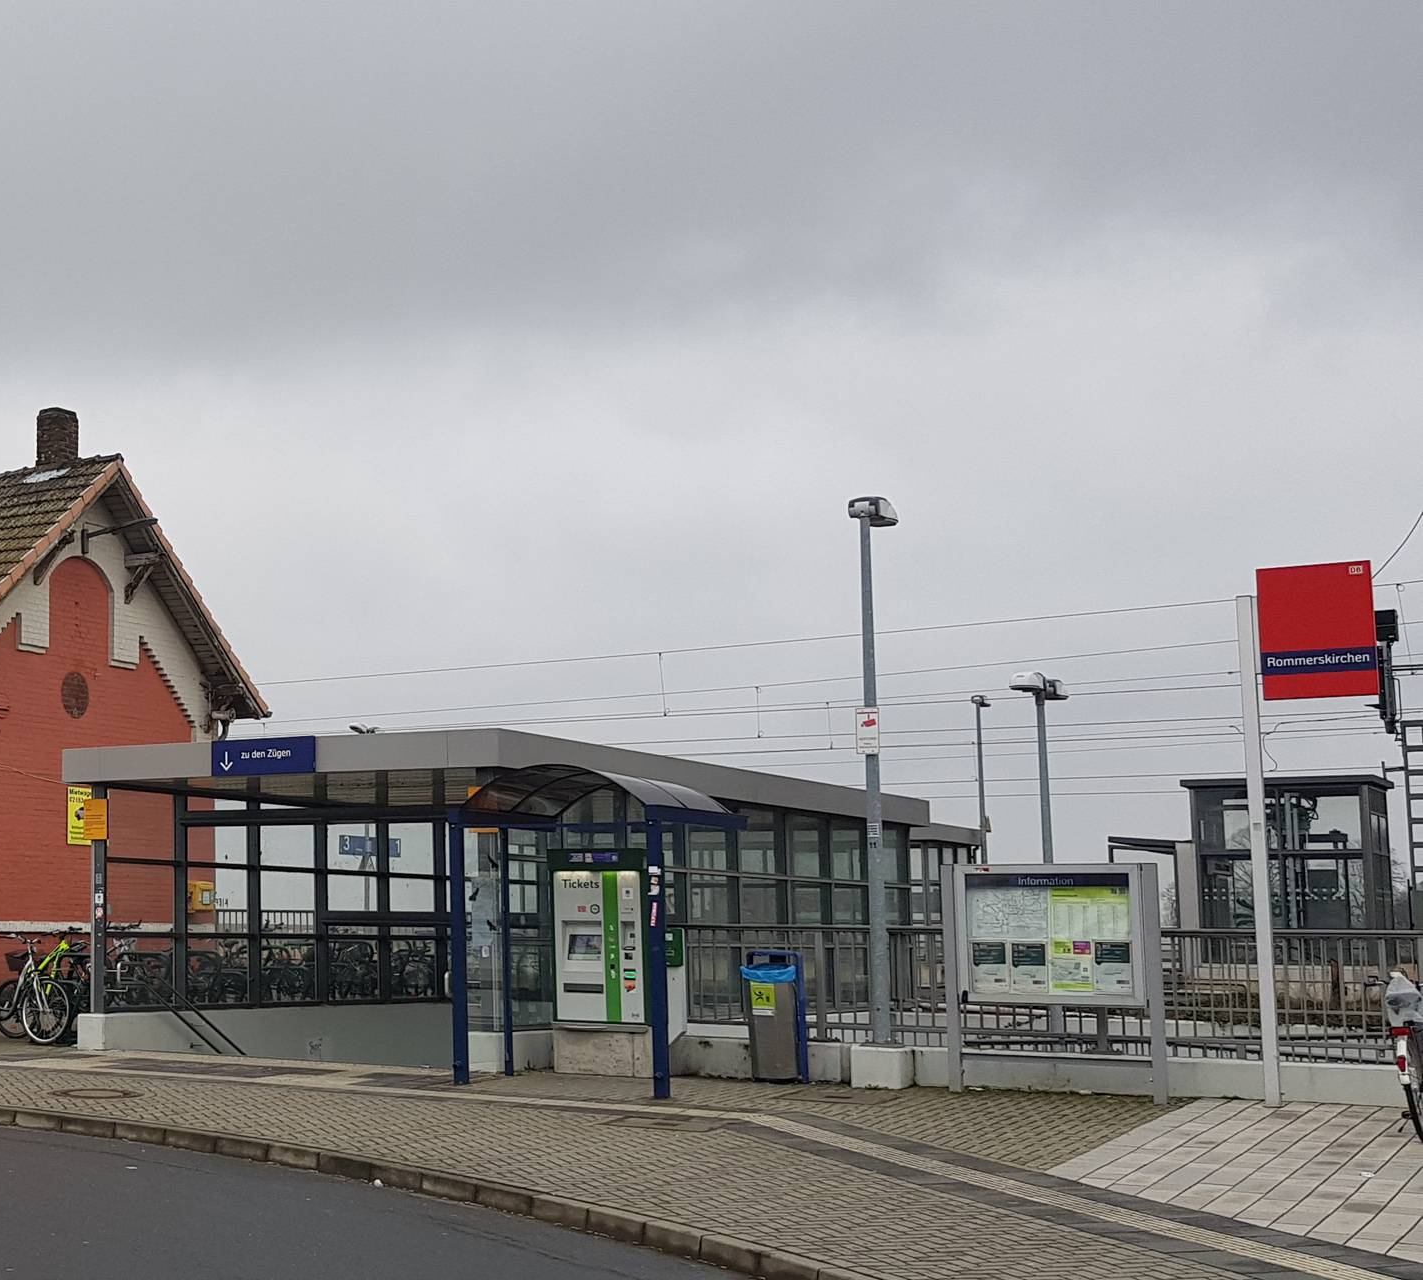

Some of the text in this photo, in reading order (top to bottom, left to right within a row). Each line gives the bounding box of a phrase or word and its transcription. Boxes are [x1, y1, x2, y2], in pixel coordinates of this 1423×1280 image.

[1267, 652, 1370, 667] Rommerskirchen
[240, 748, 291, 759] zu den Zügen
[343, 836, 400, 854] 3 1
[562, 879, 600, 889] Tickets
[1018, 876, 1074, 886] Information
